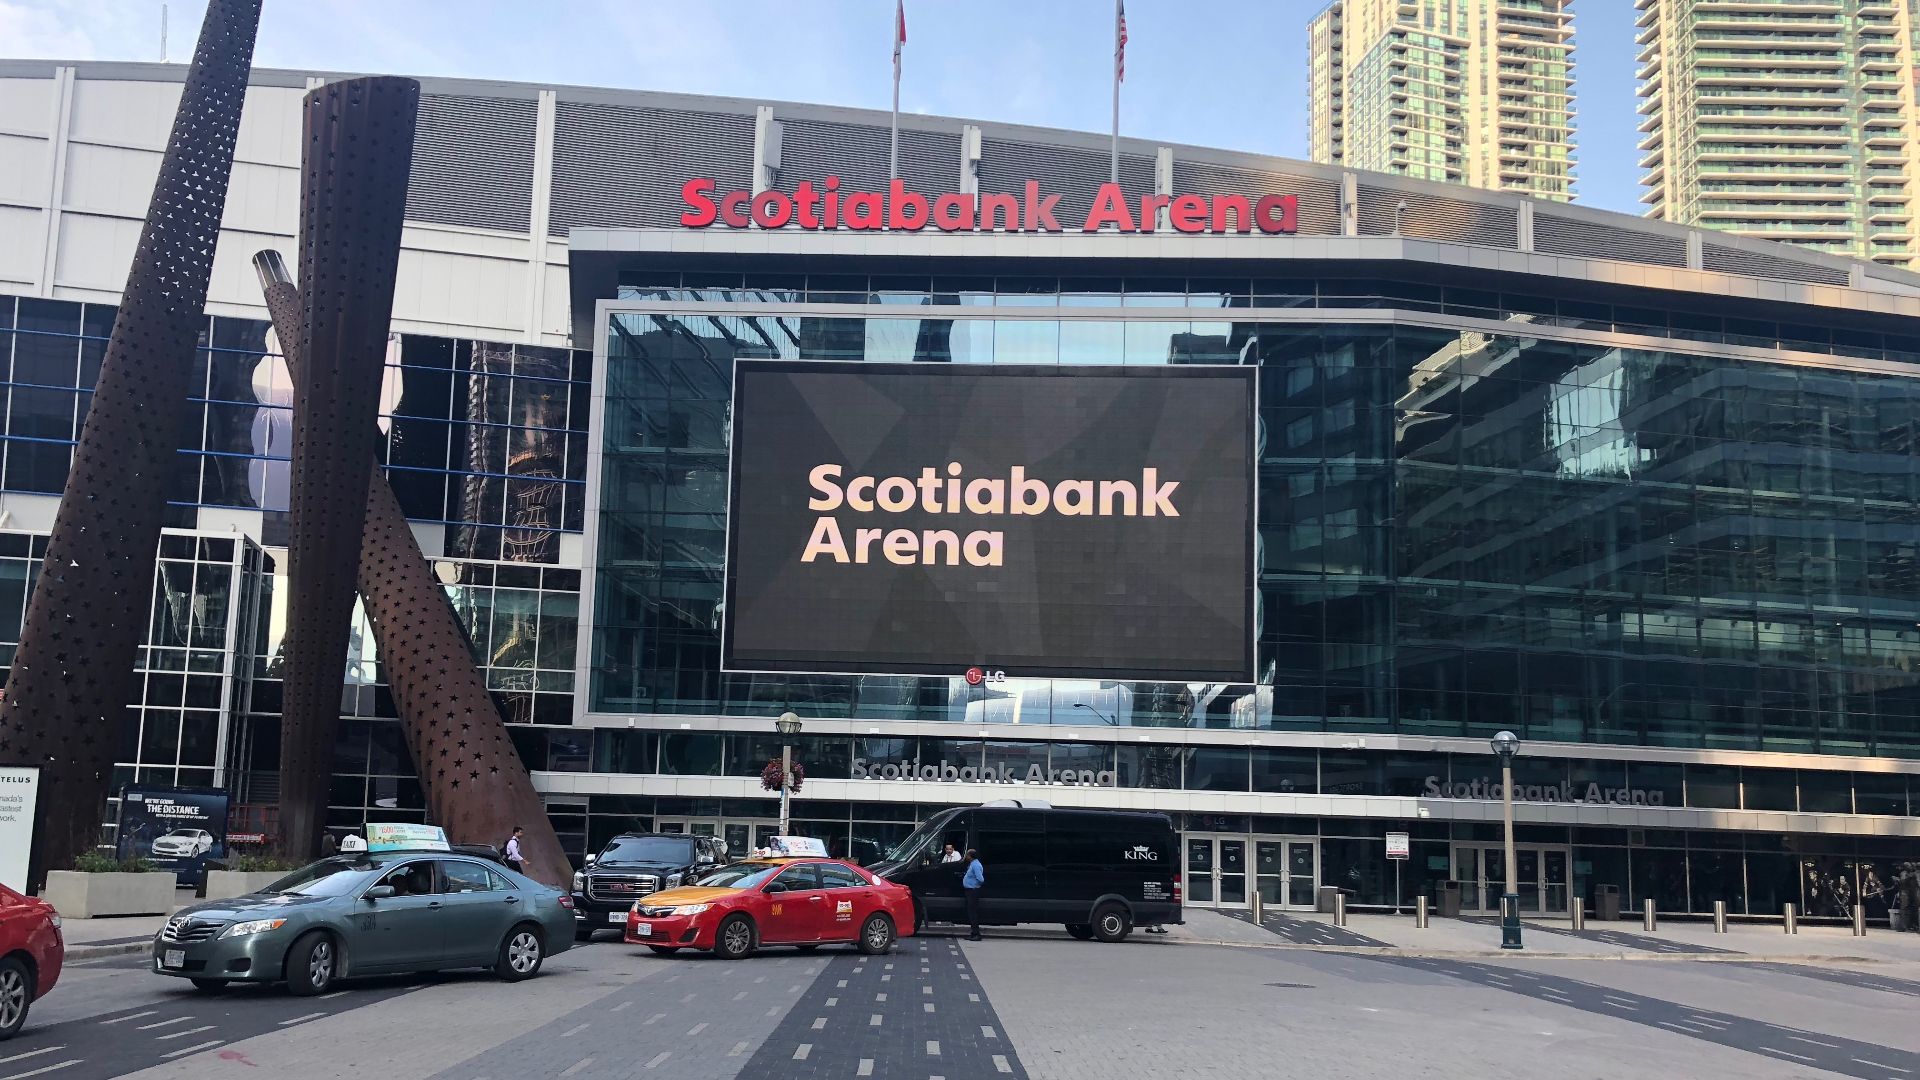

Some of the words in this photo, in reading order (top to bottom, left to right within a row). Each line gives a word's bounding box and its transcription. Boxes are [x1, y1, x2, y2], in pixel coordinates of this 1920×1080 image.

[680, 176, 1064, 232] Scotiabank
[1083, 183, 1298, 233] Arena
[808, 462, 1180, 517] Scotiabank
[800, 516, 1004, 567] Arena
[986, 670, 1005, 682] LG
[851, 757, 1015, 785] Scotiabank
[1024, 763, 1116, 787] Arena
[1424, 775, 1576, 803] Scotiabank
[1584, 782, 1664, 806] Arena
[147, 804, 163, 813] THE
[163, 805, 200, 815] DISTANCE
[1124, 850, 1157, 860] KING
